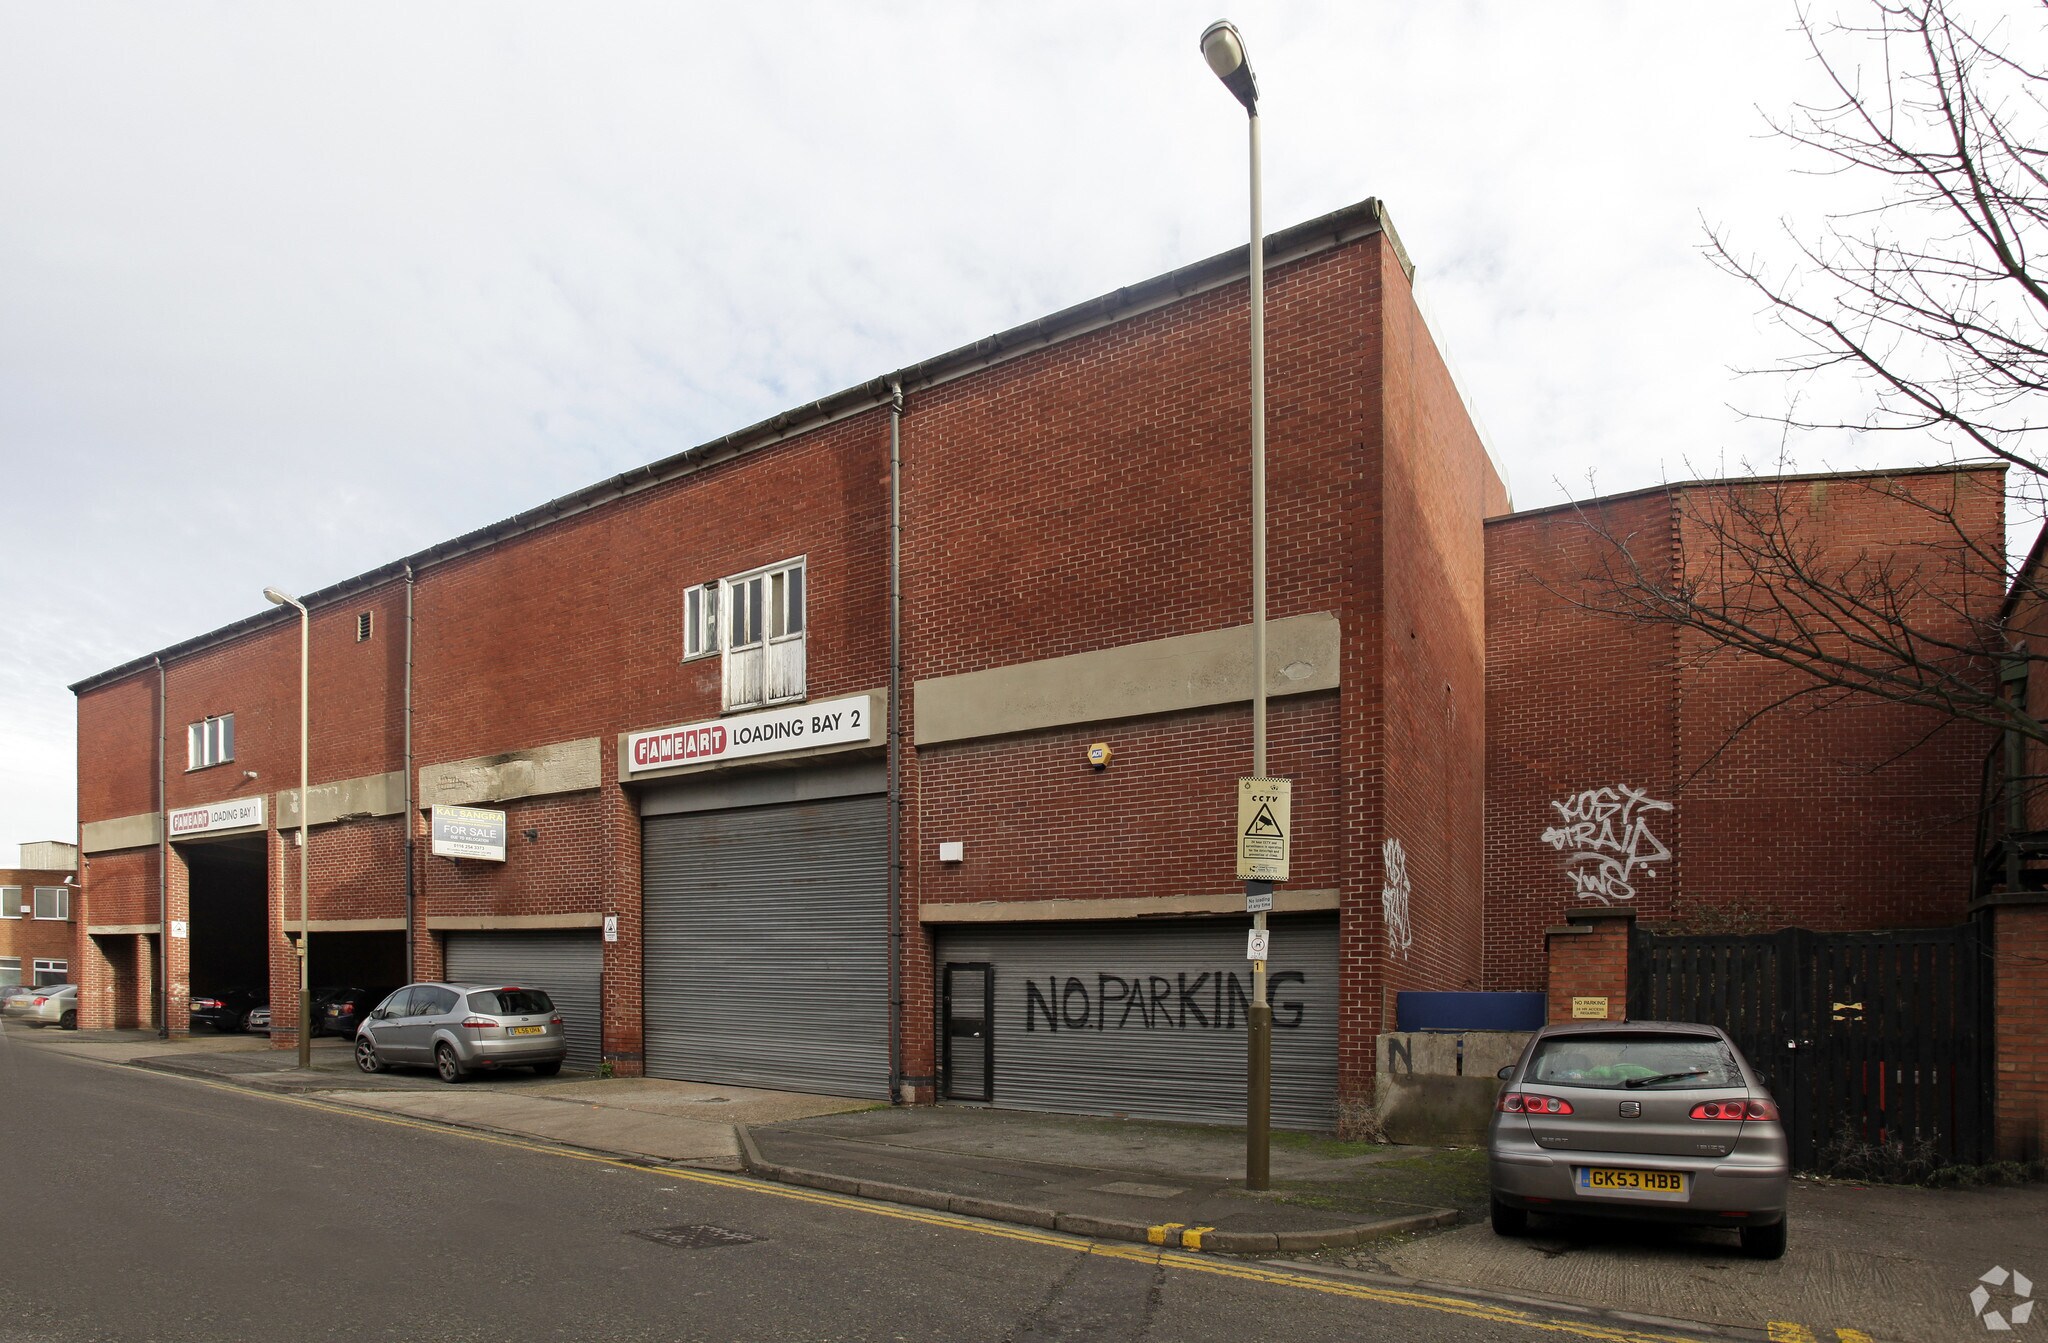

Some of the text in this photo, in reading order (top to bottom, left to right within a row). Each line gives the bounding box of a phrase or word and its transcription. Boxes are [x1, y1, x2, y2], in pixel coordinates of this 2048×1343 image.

[636, 710, 860, 763] FAMEART LOADING BAY 2
[1252, 795, 1278, 803] CCTV
[173, 806, 257, 831] FAMEART LOADING BAY 1
[436, 808, 503, 822] KAL SANGRA
[443, 825, 497, 839] FOR SALE
[1255, 962, 1259, 970] 1
[1388, 1037, 1413, 1075] N
[1593, 1171, 1681, 1190] GK53 HBB
